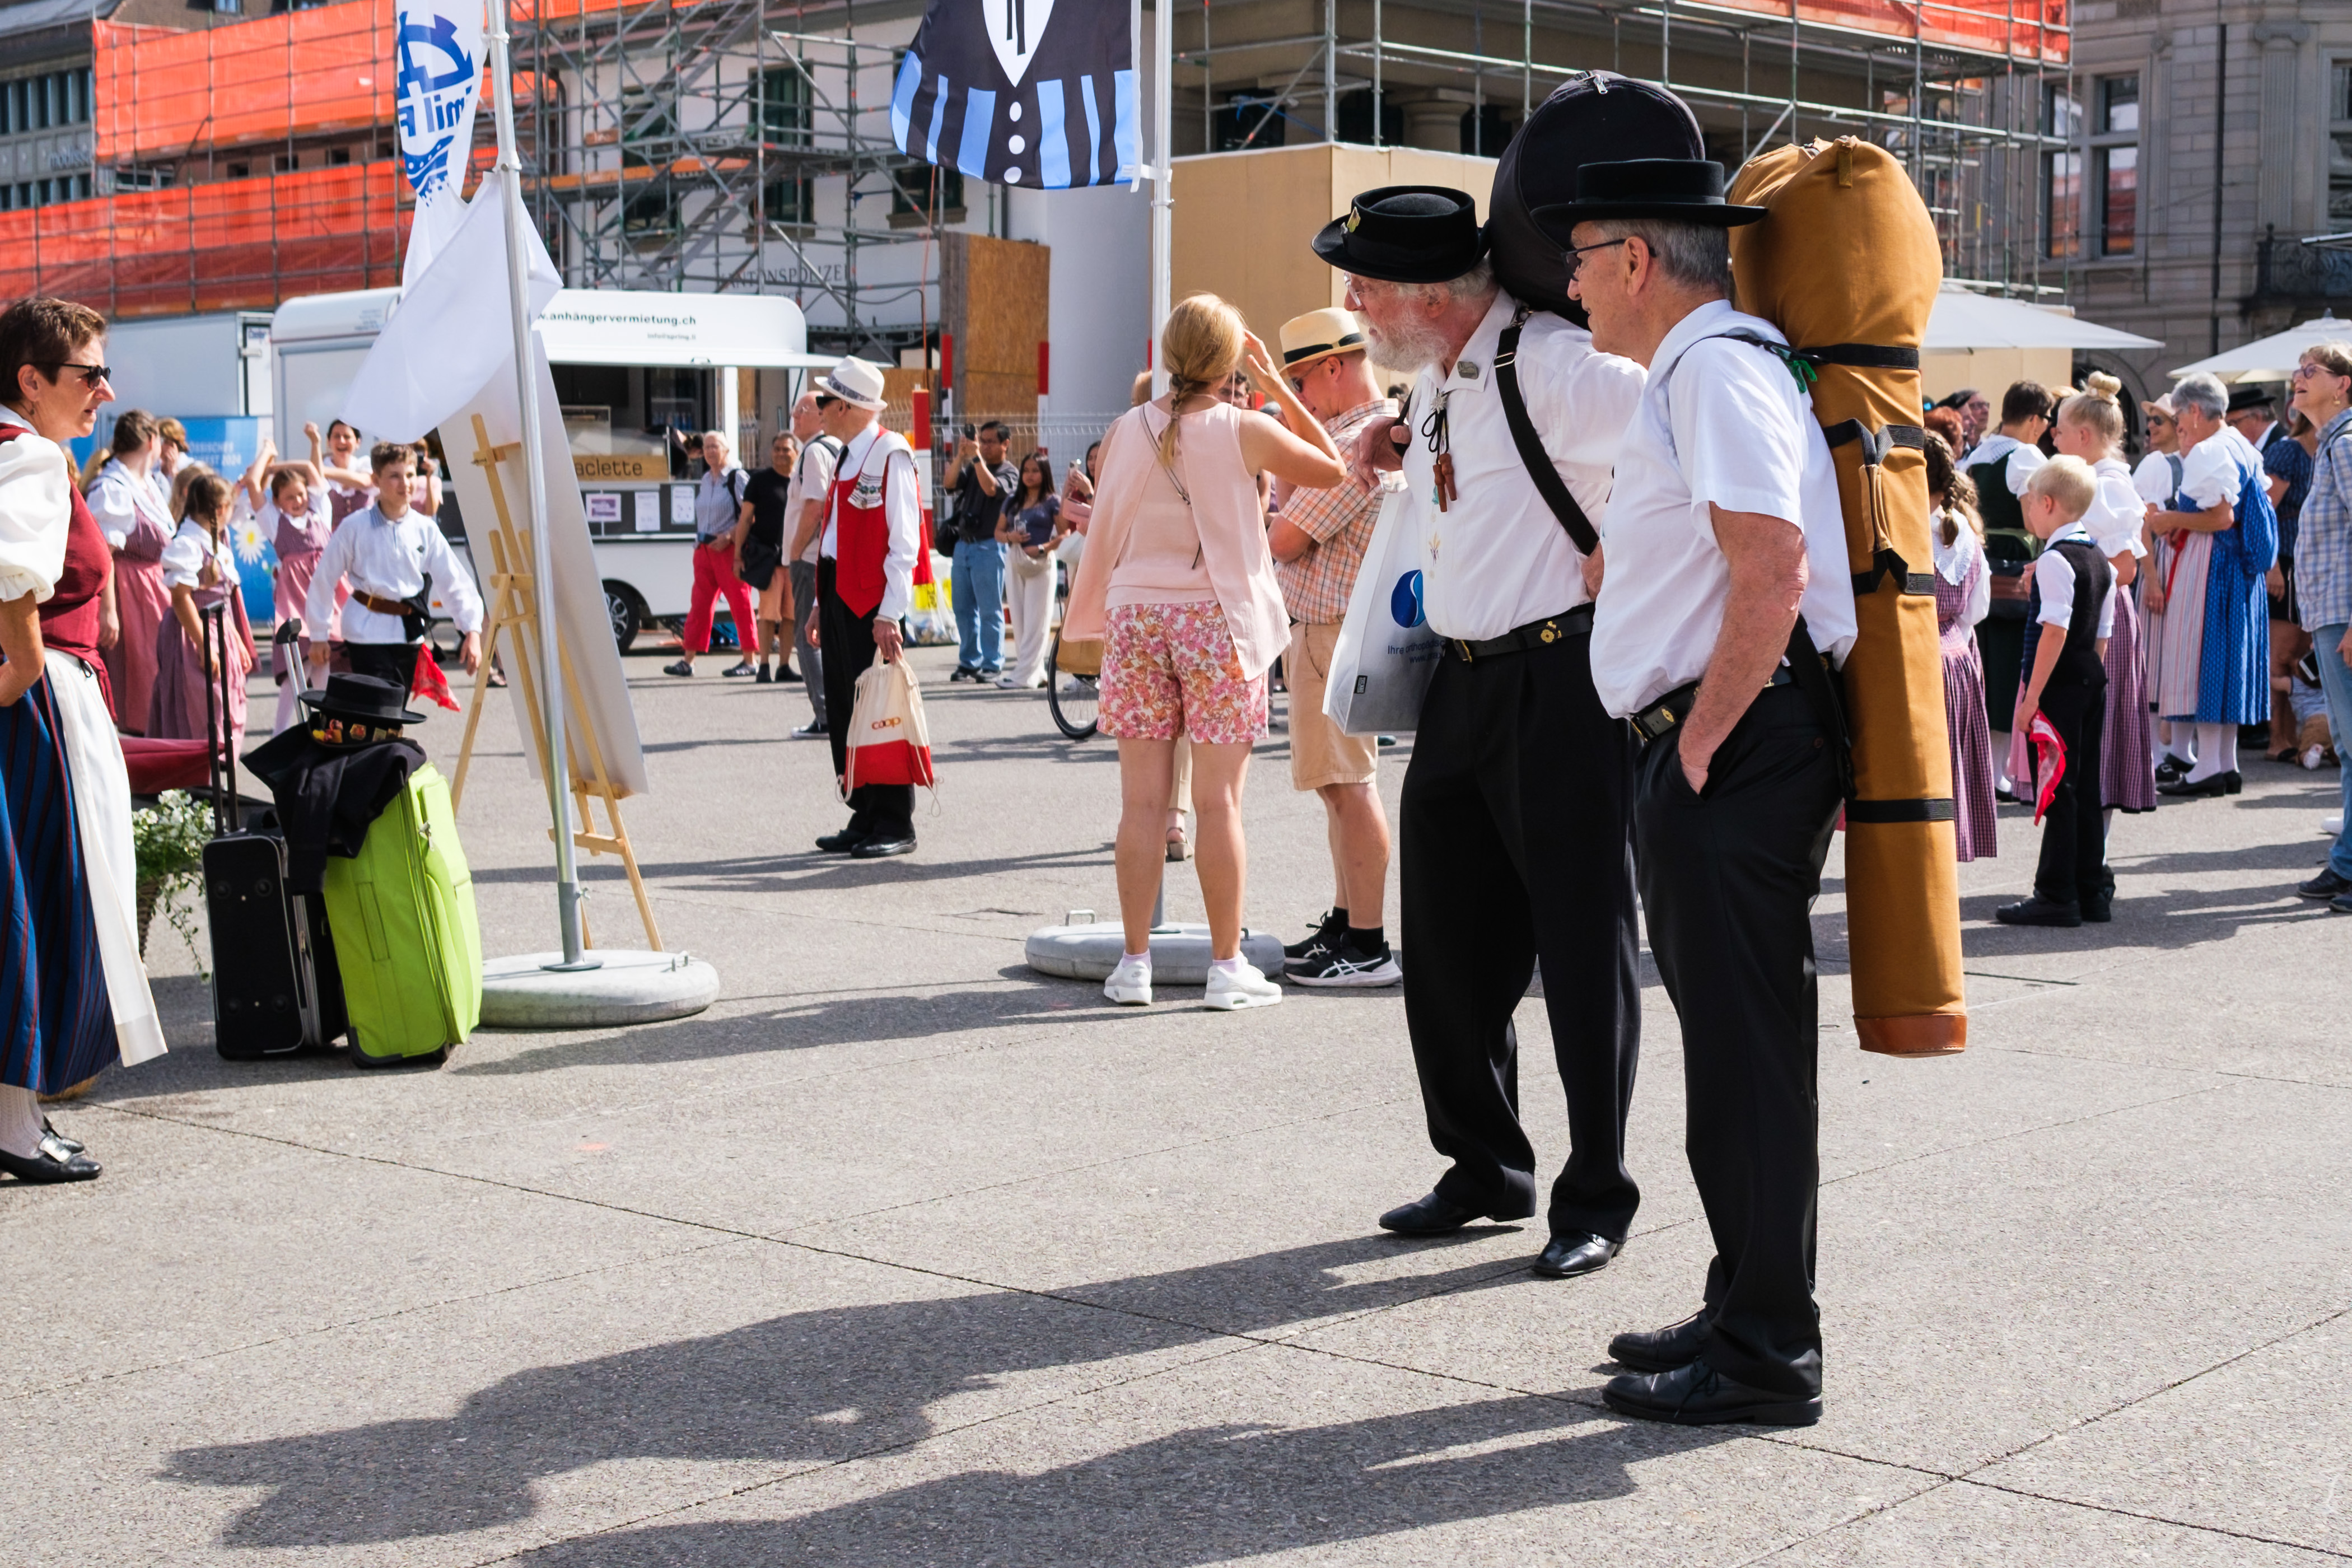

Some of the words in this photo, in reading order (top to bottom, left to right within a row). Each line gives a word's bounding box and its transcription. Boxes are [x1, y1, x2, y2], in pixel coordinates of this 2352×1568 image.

[537, 311, 696, 326] w.anhängervermietung.ch
[575, 457, 642, 476] aclette
[1388, 645, 1404, 654] Ihre
[871, 717, 901, 730] coop
